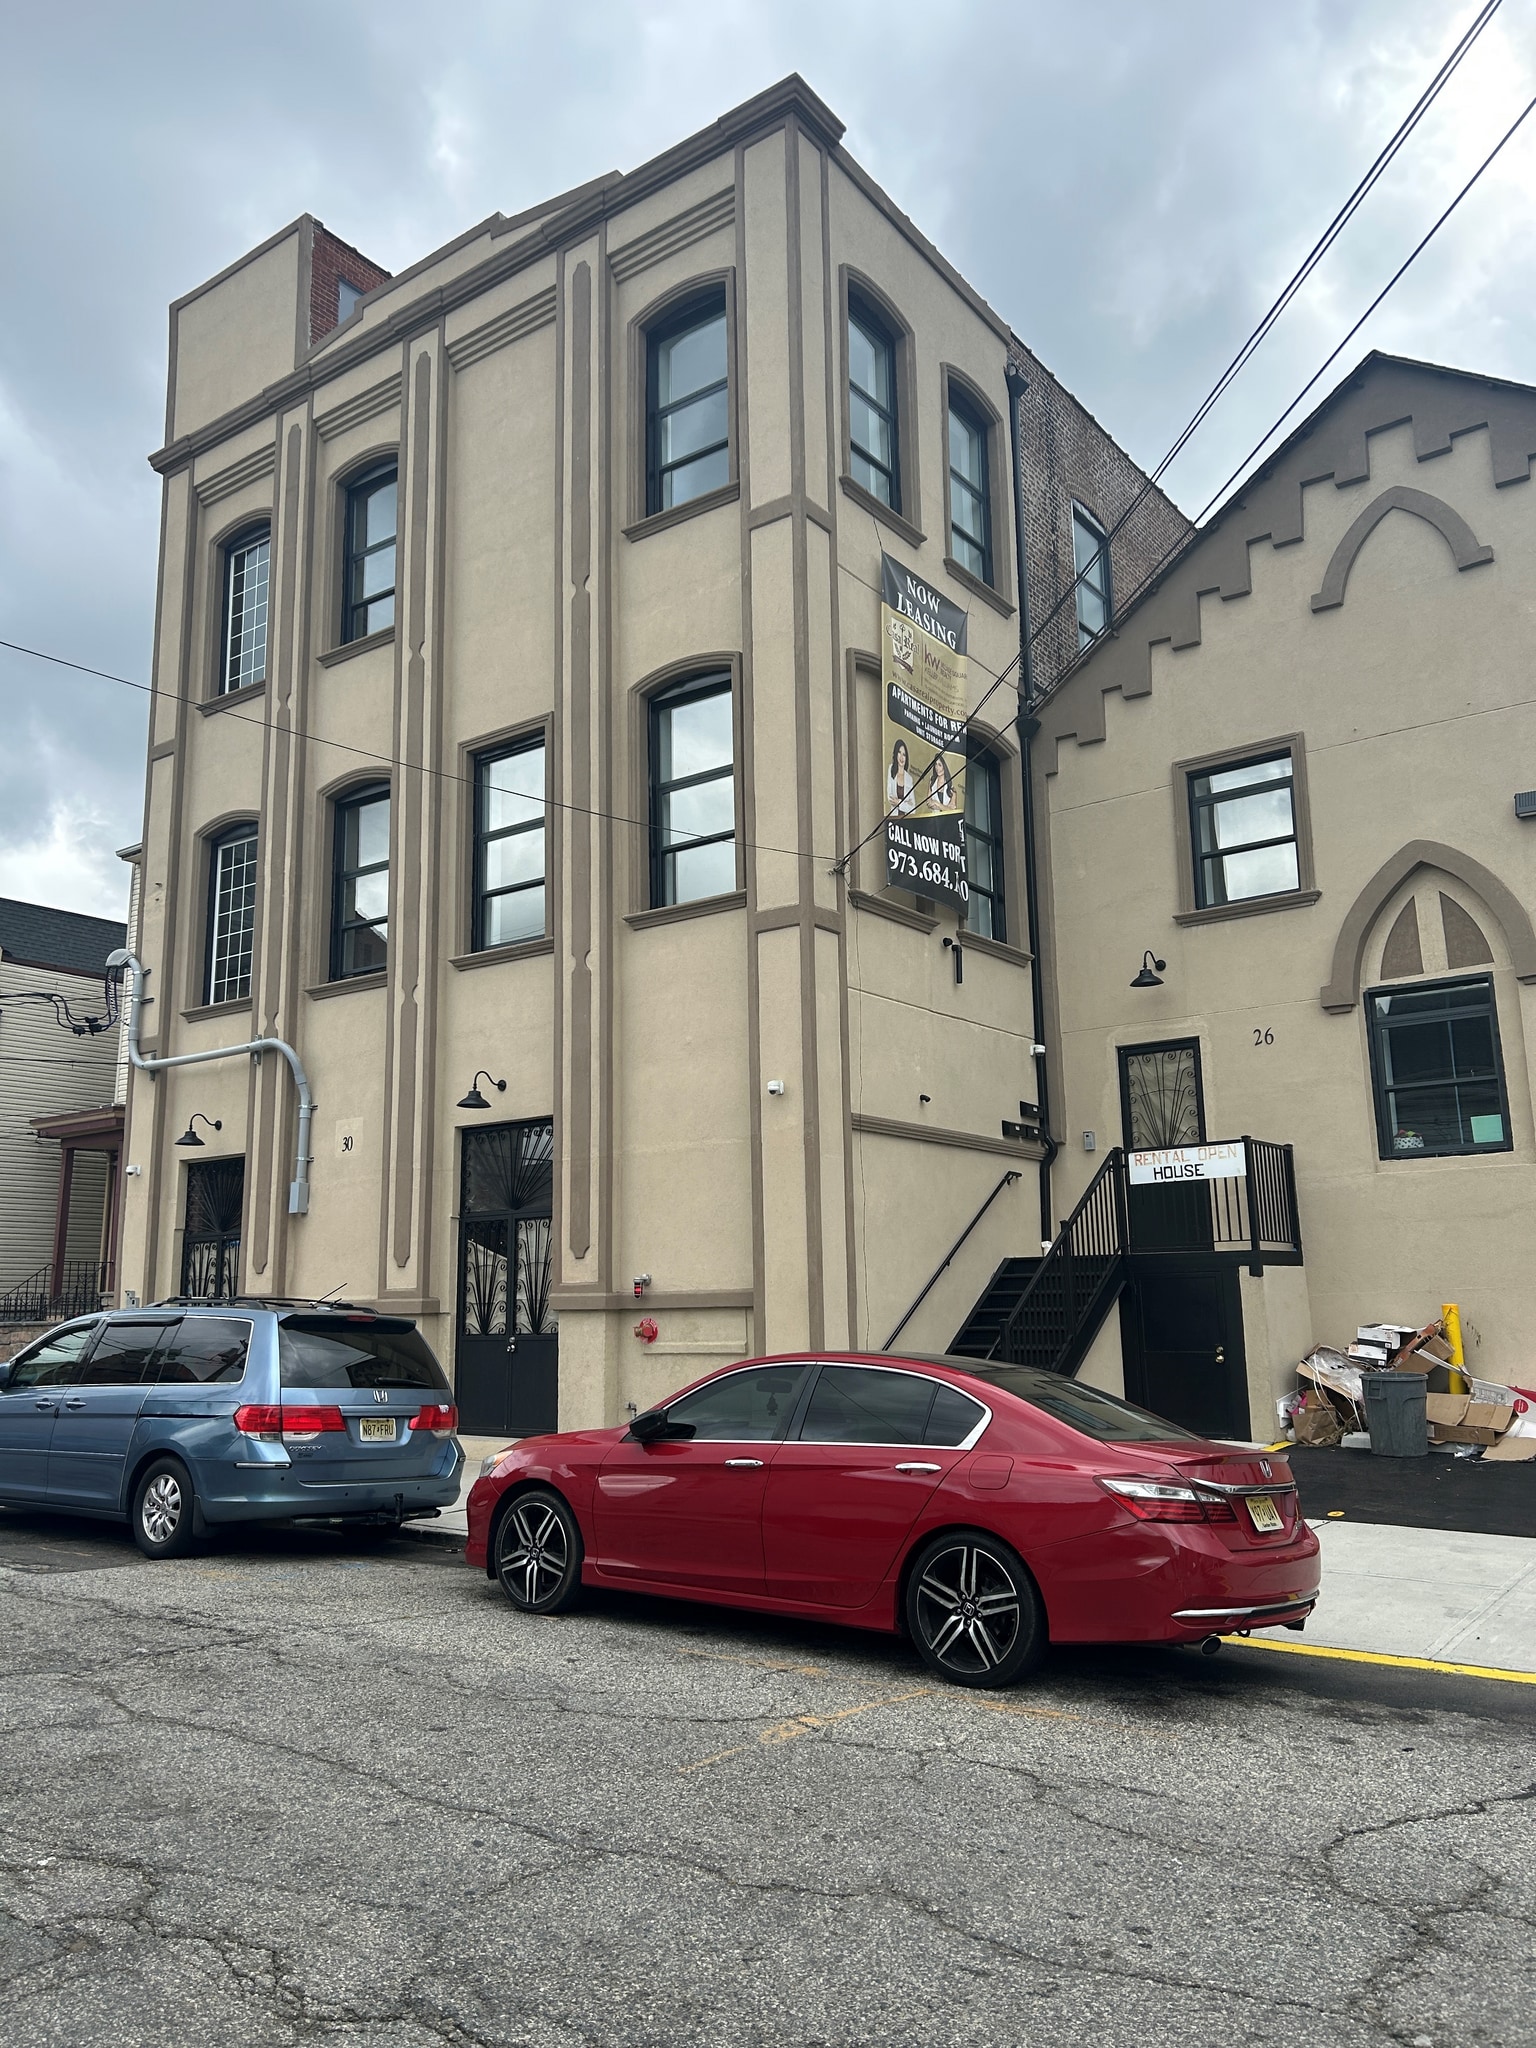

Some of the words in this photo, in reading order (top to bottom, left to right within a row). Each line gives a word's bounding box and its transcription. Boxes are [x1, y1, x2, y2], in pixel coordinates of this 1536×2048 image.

[906, 575, 940, 614] NOW
[896, 592, 956, 650] LEASING
[892, 685, 933, 721] APARTMENTS
[935, 713, 948, 729] FOR
[926, 731, 944, 747] STORAGE
[889, 822, 912, 848] CALL
[913, 832, 939, 856] NOW
[942, 841, 960, 864] FOR
[1253, 1027, 1274, 1046] 26
[342, 1136, 353, 1152] 30
[1134, 1150, 1190, 1167] RENTAL
[1198, 1145, 1237, 1161] OPEN
[1153, 1163, 1204, 1180] HOUSE
